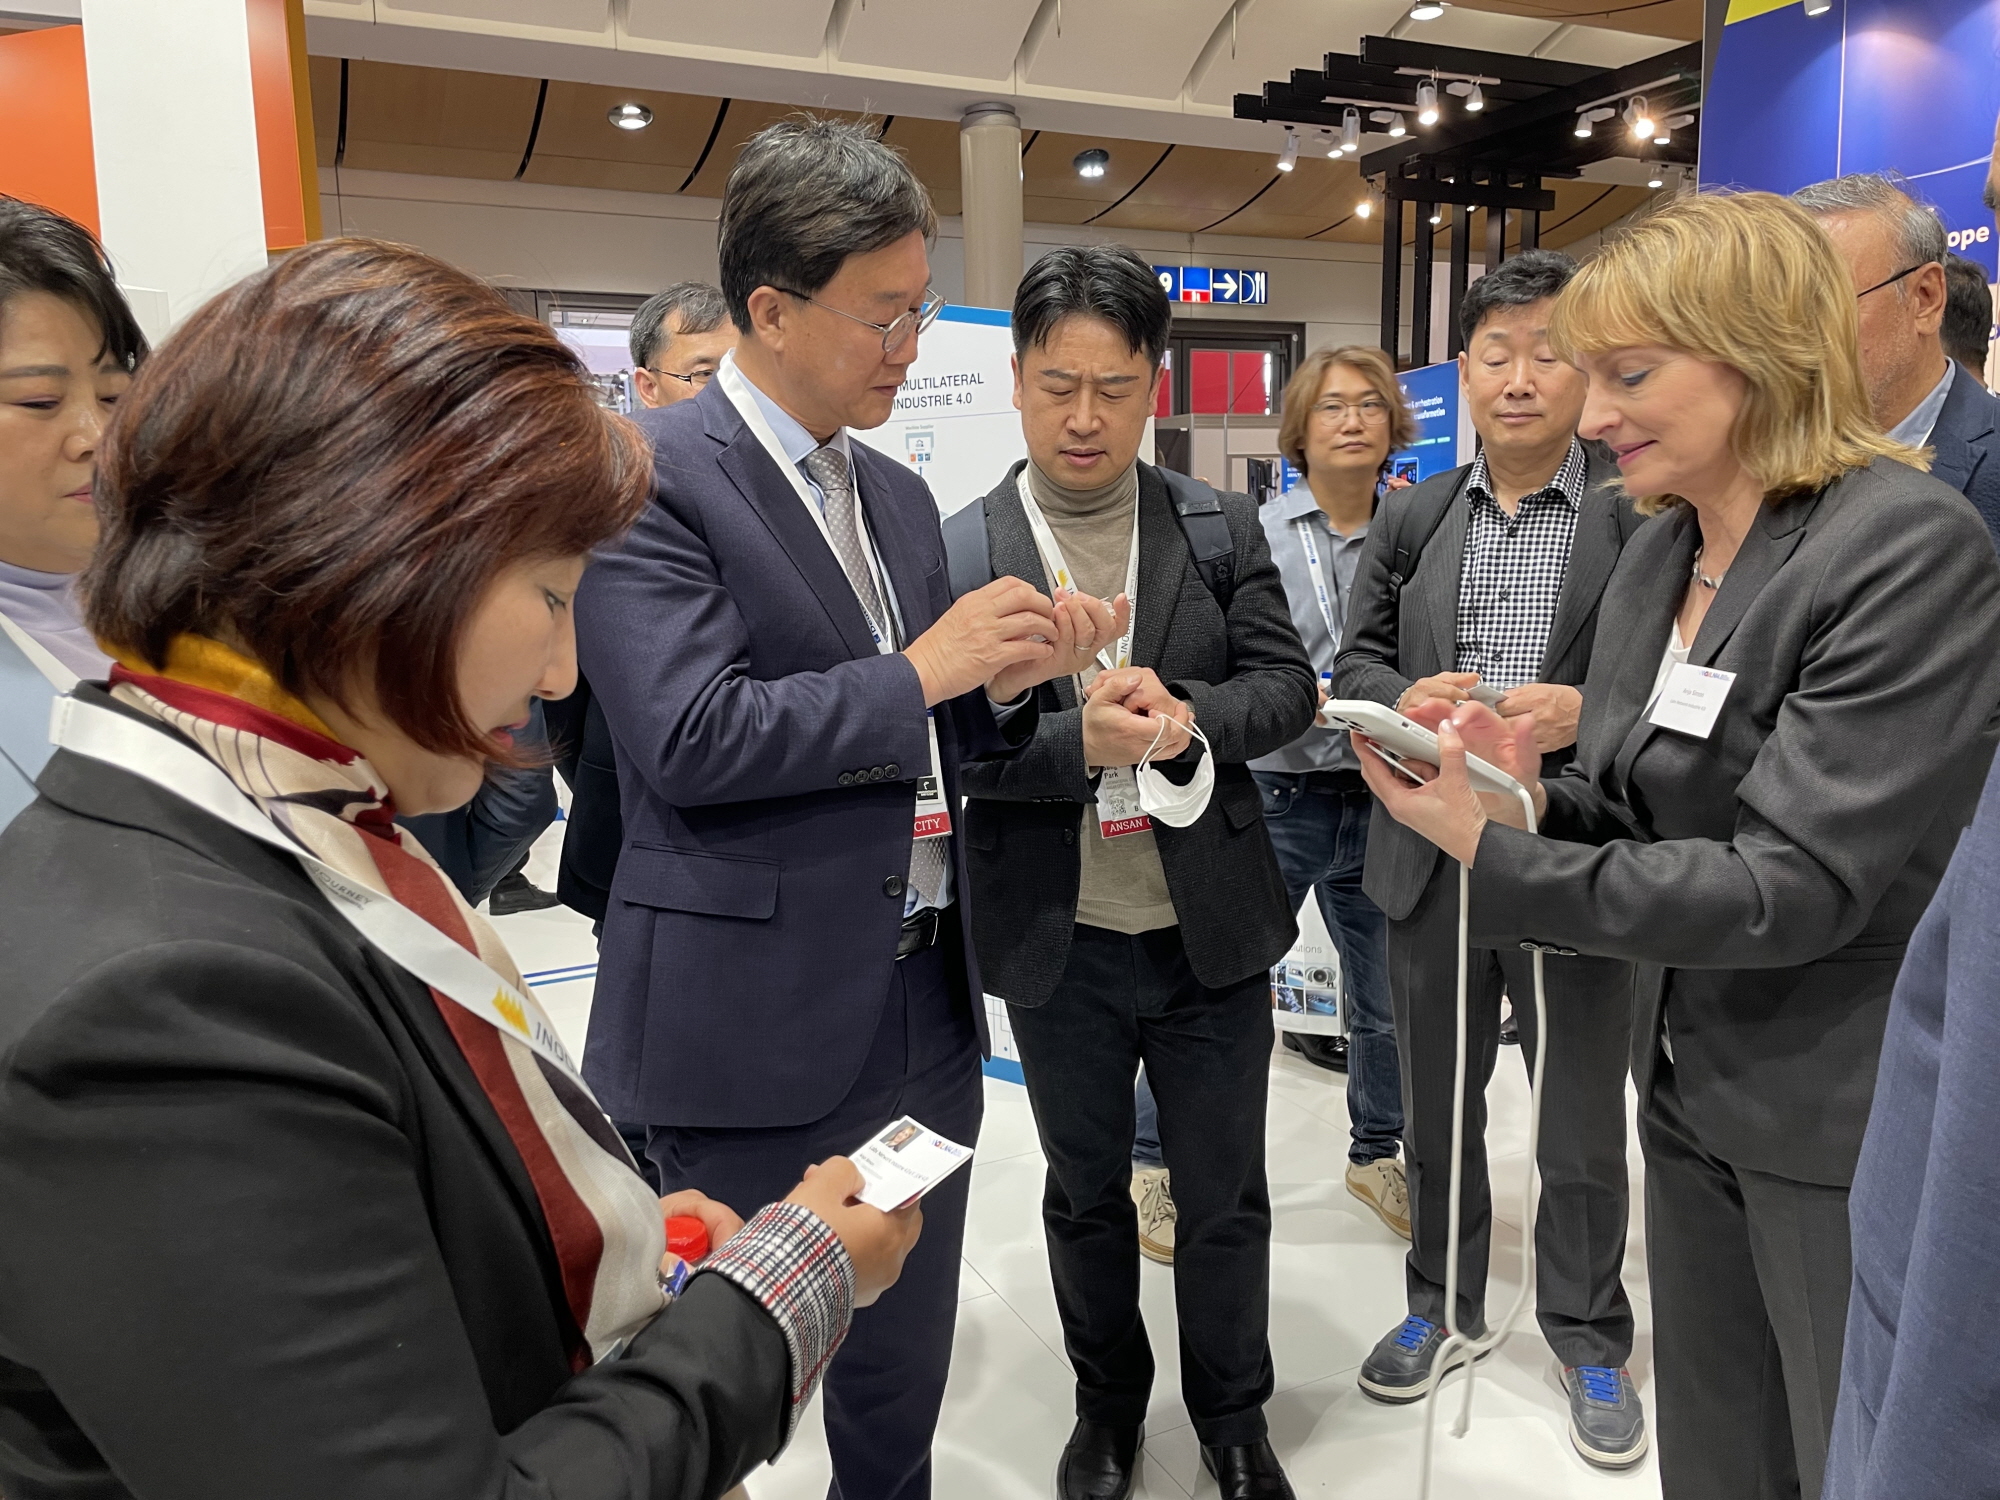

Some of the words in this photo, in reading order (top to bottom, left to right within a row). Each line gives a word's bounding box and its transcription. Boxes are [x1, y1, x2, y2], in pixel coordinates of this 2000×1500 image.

[1947, 226, 1989, 250] ope
[899, 372, 984, 391] MULTILATERAL
[893, 394, 953, 410] INDUSTRIE
[956, 392, 972, 405] 4.0
[1104, 771, 1119, 779] Park
[914, 818, 941, 832] CITY
[1110, 818, 1143, 833] ANSAN
[1292, 944, 1323, 954] lutions
